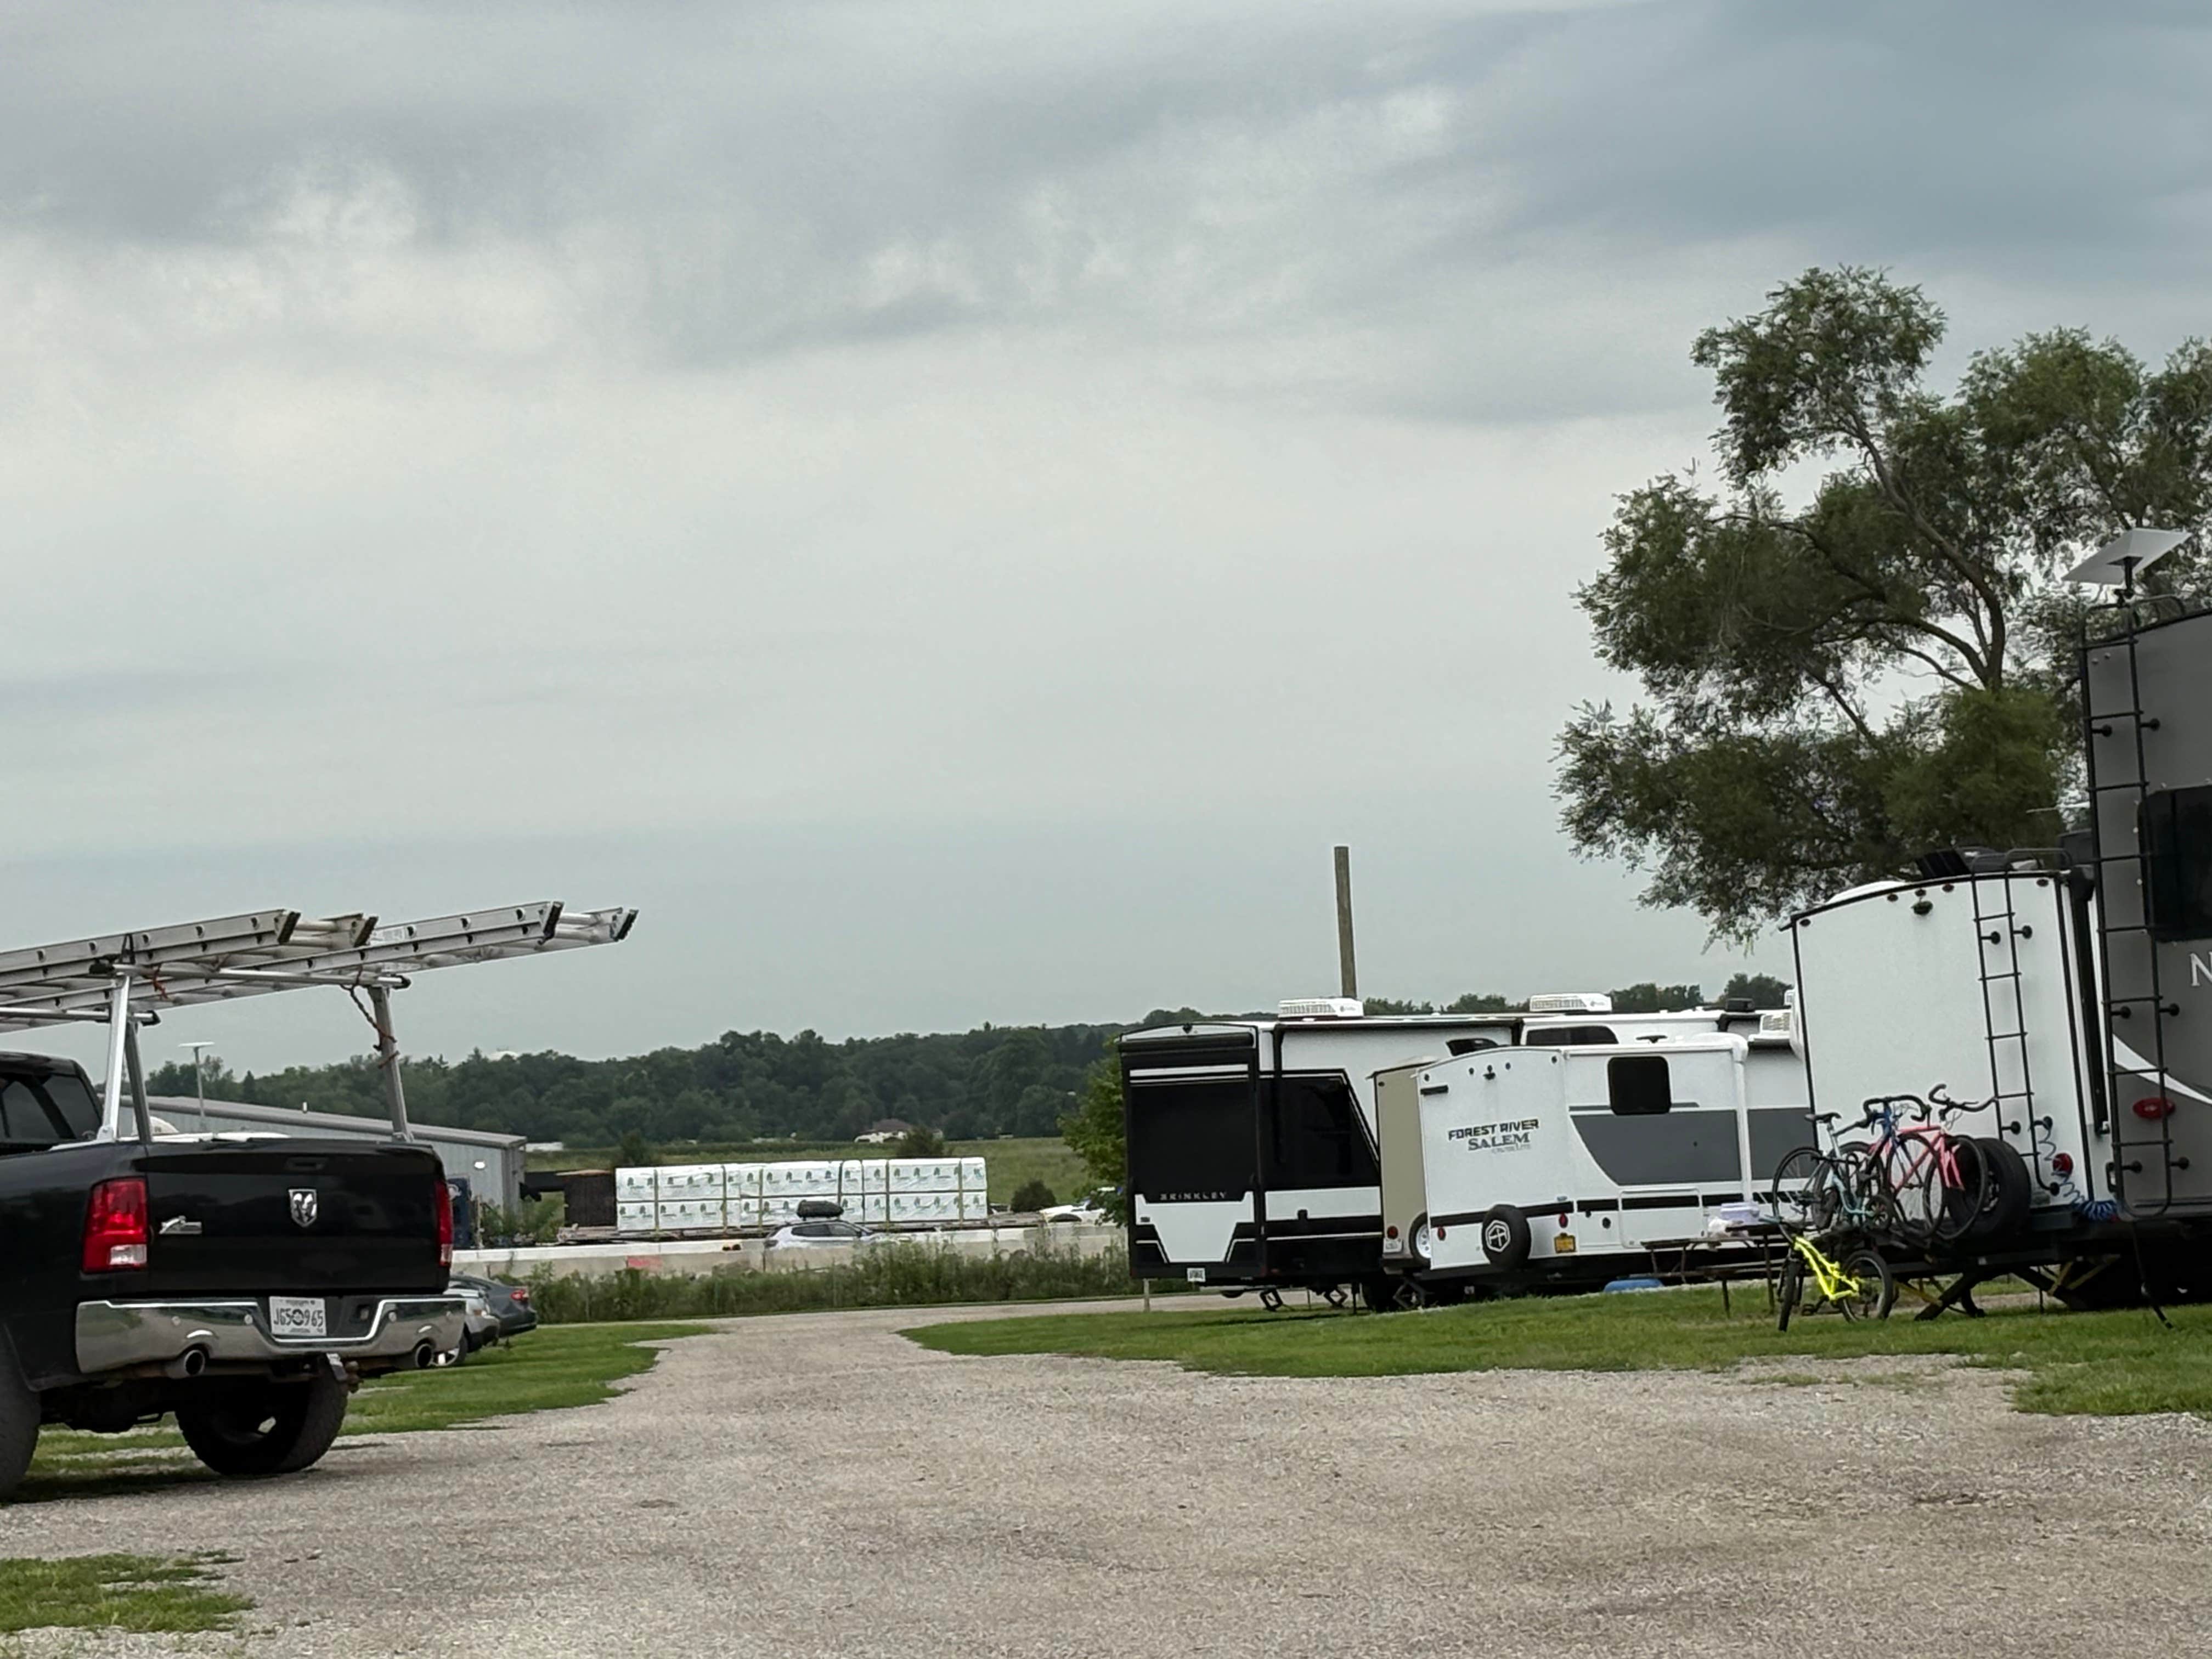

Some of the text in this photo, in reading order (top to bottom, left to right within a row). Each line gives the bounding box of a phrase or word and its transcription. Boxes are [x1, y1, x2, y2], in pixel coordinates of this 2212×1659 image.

[1448, 1119, 1539, 1141] FOREST RIVER
[1468, 1132, 1530, 1151] SALEM
